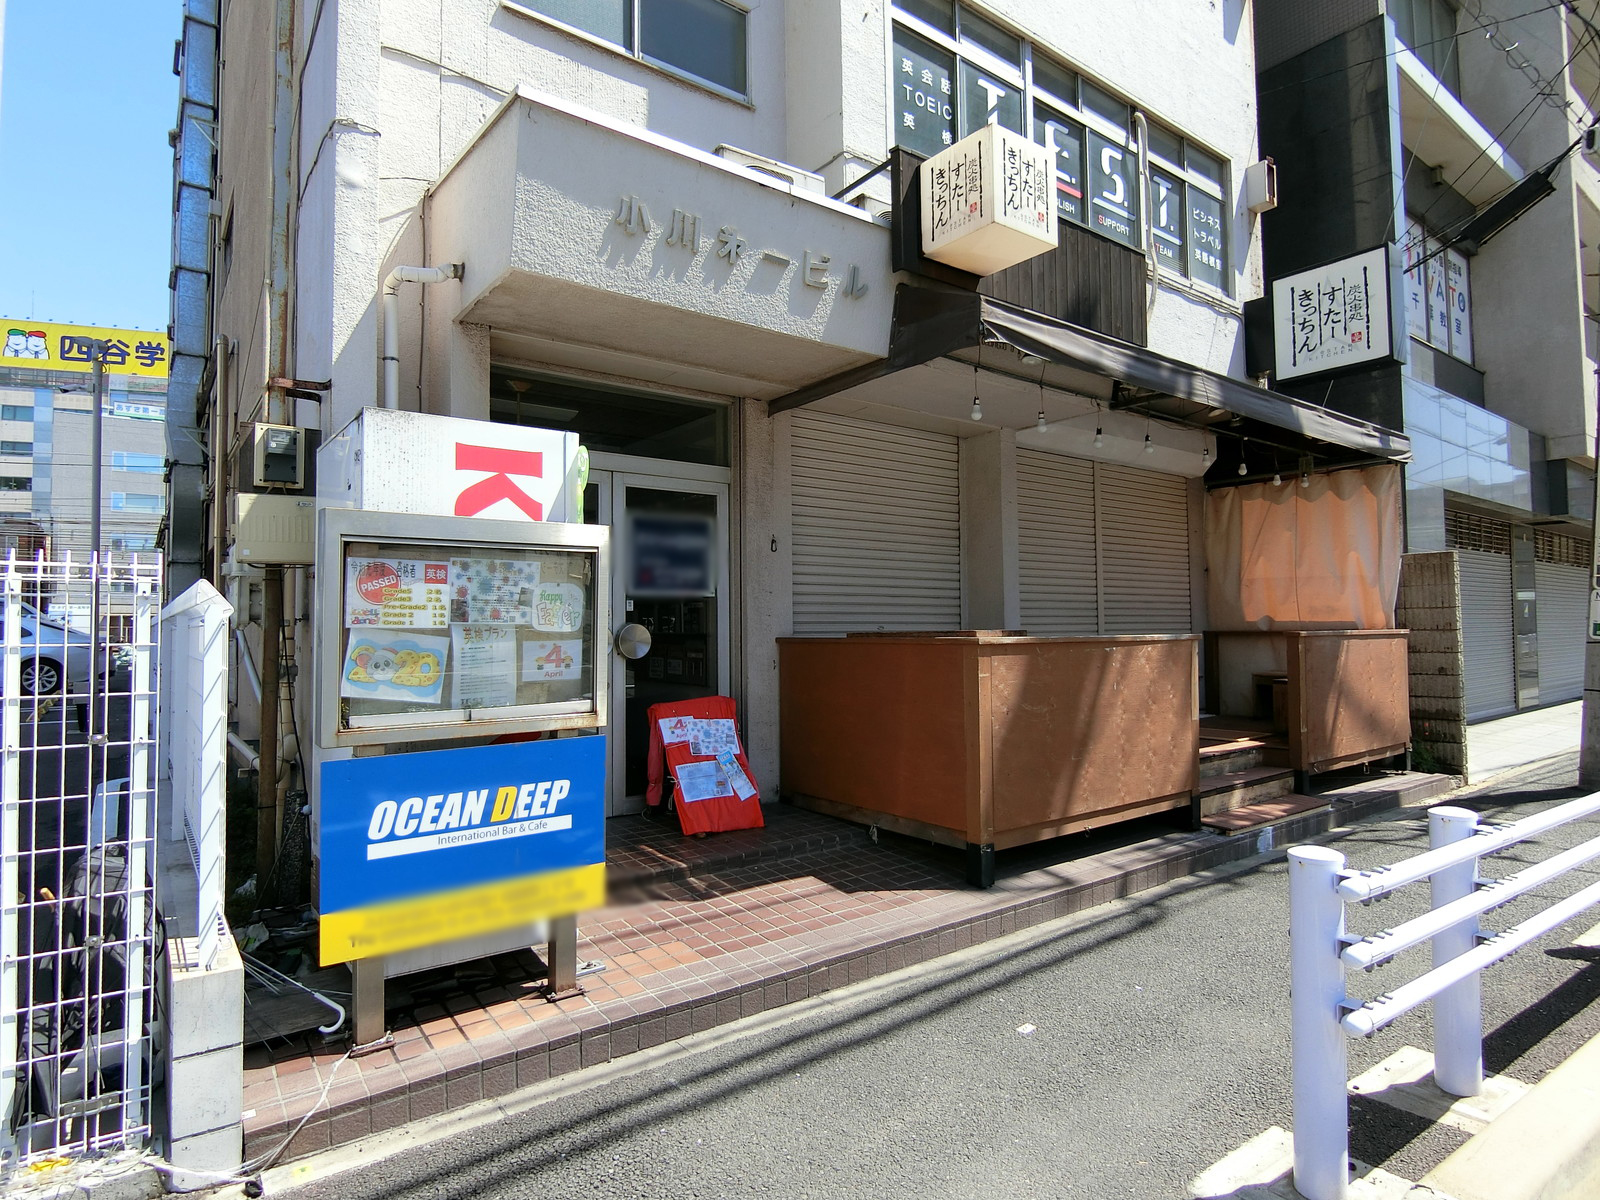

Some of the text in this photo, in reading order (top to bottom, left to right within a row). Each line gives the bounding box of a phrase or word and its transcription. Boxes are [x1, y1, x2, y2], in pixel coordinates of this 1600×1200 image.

[901, 57, 951, 95] 英会話
[903, 84, 953, 121] TOEIC
[1006, 146, 1020, 211] きっちん
[935, 168, 949, 229] きっちん
[1056, 198, 1174, 259] LISH SUPPORT TEAM
[1193, 227, 1222, 250] トラベル
[1298, 289, 1318, 354] きっちん
[1322, 286, 1342, 338] すたー
[60, 335, 165, 368] 四谷学
[360, 574, 397, 593] PASSED
[426, 568, 447, 580] 英検
[536, 601, 580, 627] Easter
[540, 590, 563, 604] Happy
[544, 644, 566, 668] 4
[367, 779, 571, 841] OCEAN DEEP
[437, 819, 548, 846] International Bar & Cafe
